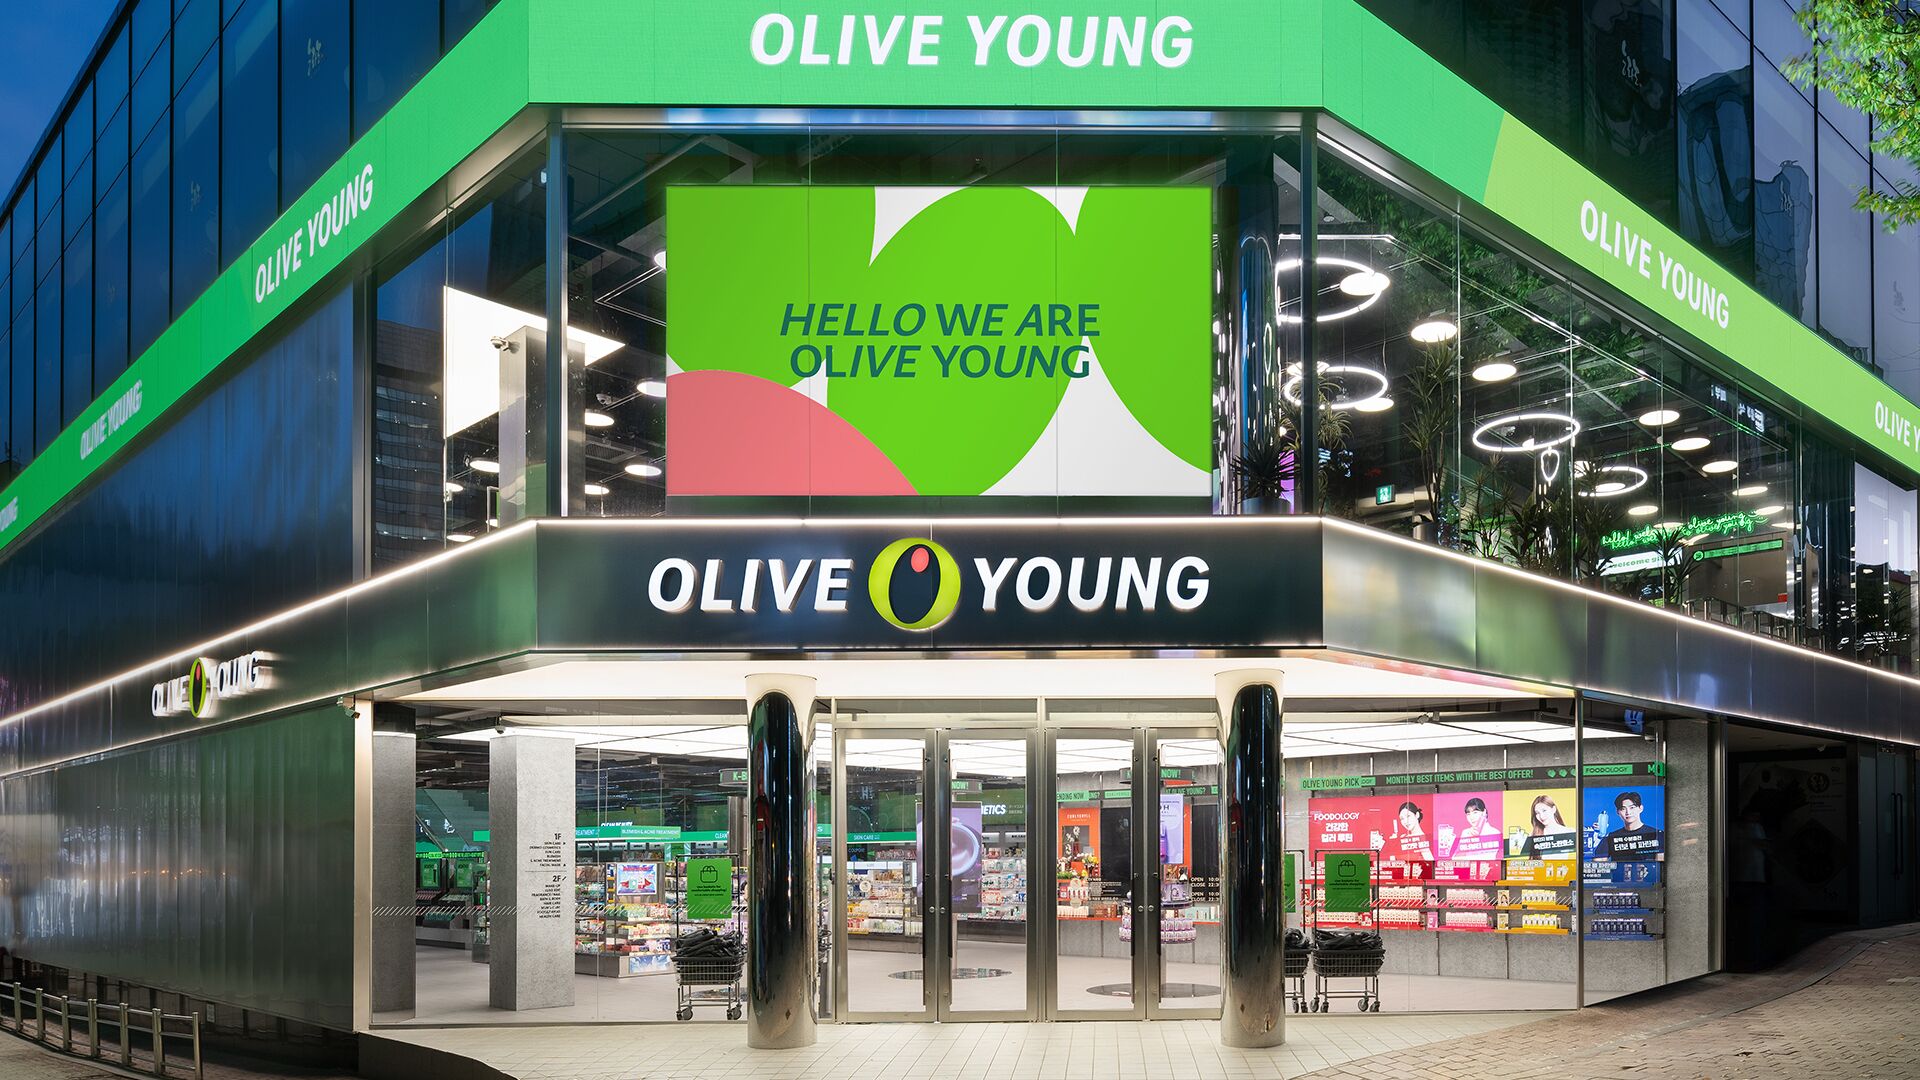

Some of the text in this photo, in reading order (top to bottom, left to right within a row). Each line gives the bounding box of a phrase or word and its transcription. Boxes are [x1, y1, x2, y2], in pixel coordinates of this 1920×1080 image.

[750, 14, 1194, 68] OLIVE YOUNG
[255, 163, 373, 303] OLIVE YOUNG
[1580, 200, 1729, 329] OLIVE YOUNG
[780, 303, 1100, 336] HELLO WE ARE
[790, 344, 1090, 379] OLIVE YOUNG
[80, 379, 143, 460] OLIVE YOUNG
[1875, 400, 1910, 448] OLIVE
[648, 556, 1211, 613] OLIVE YOUNG
[152, 675, 190, 716] OLIVE
[952, 782, 969, 790] NOW!
[1161, 769, 1181, 778] NOW!
[1185, 787, 1206, 795] YOUNG?
[1303, 778, 1360, 788] OLIVE YOUNG PICK
[1386, 769, 1533, 784] MONTHLY BEST ITEMS WITH THE BEST OFFER!
[1314, 812, 1360, 820] FOODOLOGY
